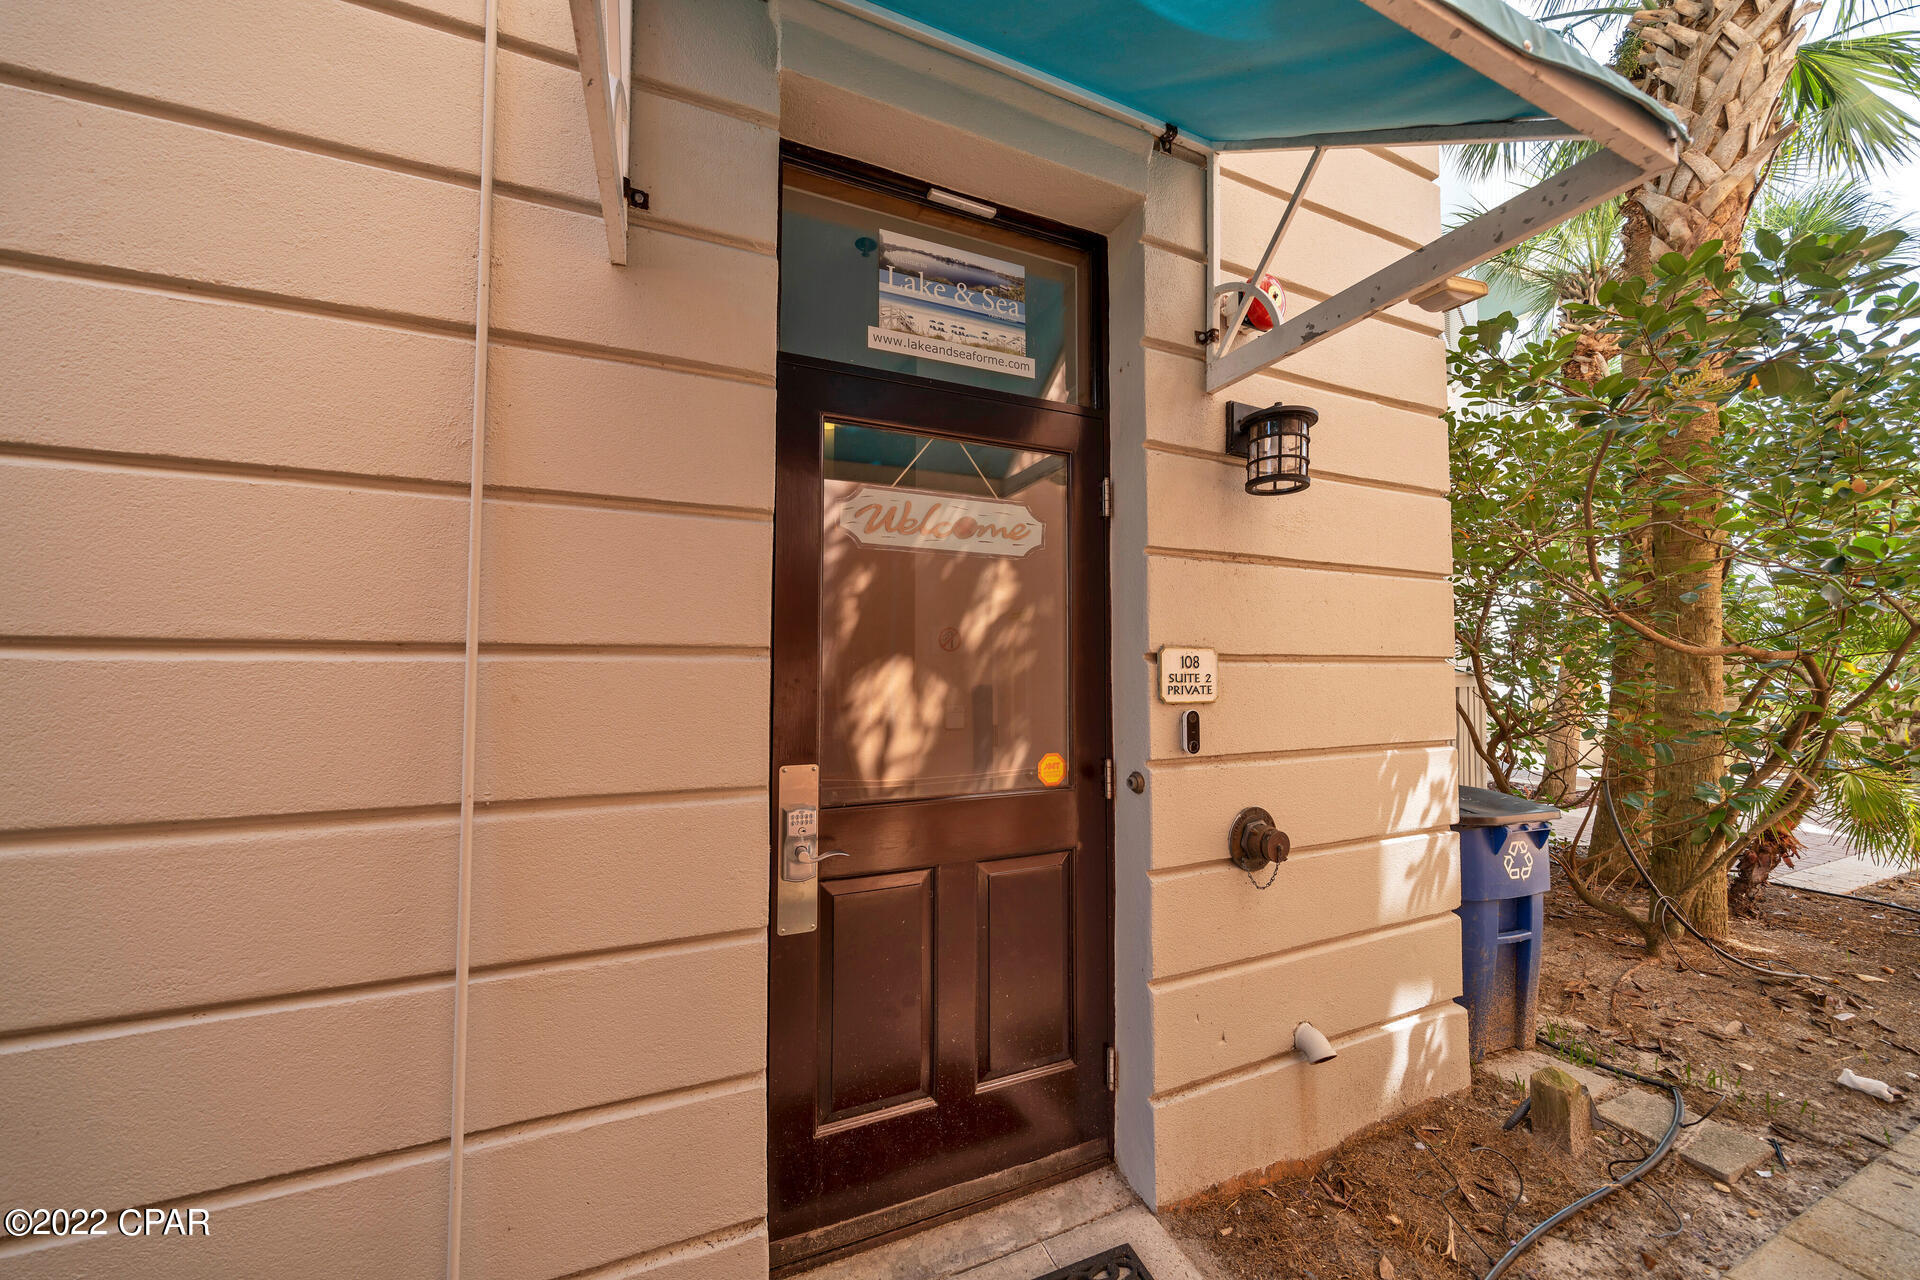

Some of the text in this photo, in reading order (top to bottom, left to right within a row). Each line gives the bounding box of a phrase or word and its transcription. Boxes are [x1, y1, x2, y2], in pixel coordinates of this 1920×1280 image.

[886, 265, 1020, 317] Lake & Sea
[873, 333, 1030, 371] www.lakeandseaforme.com
[855, 500, 1031, 541] Welcome
[1181, 655, 1200, 669] 108
[1167, 685, 1213, 695] PRIVATE
[1168, 673, 1212, 683] SUITE 2
